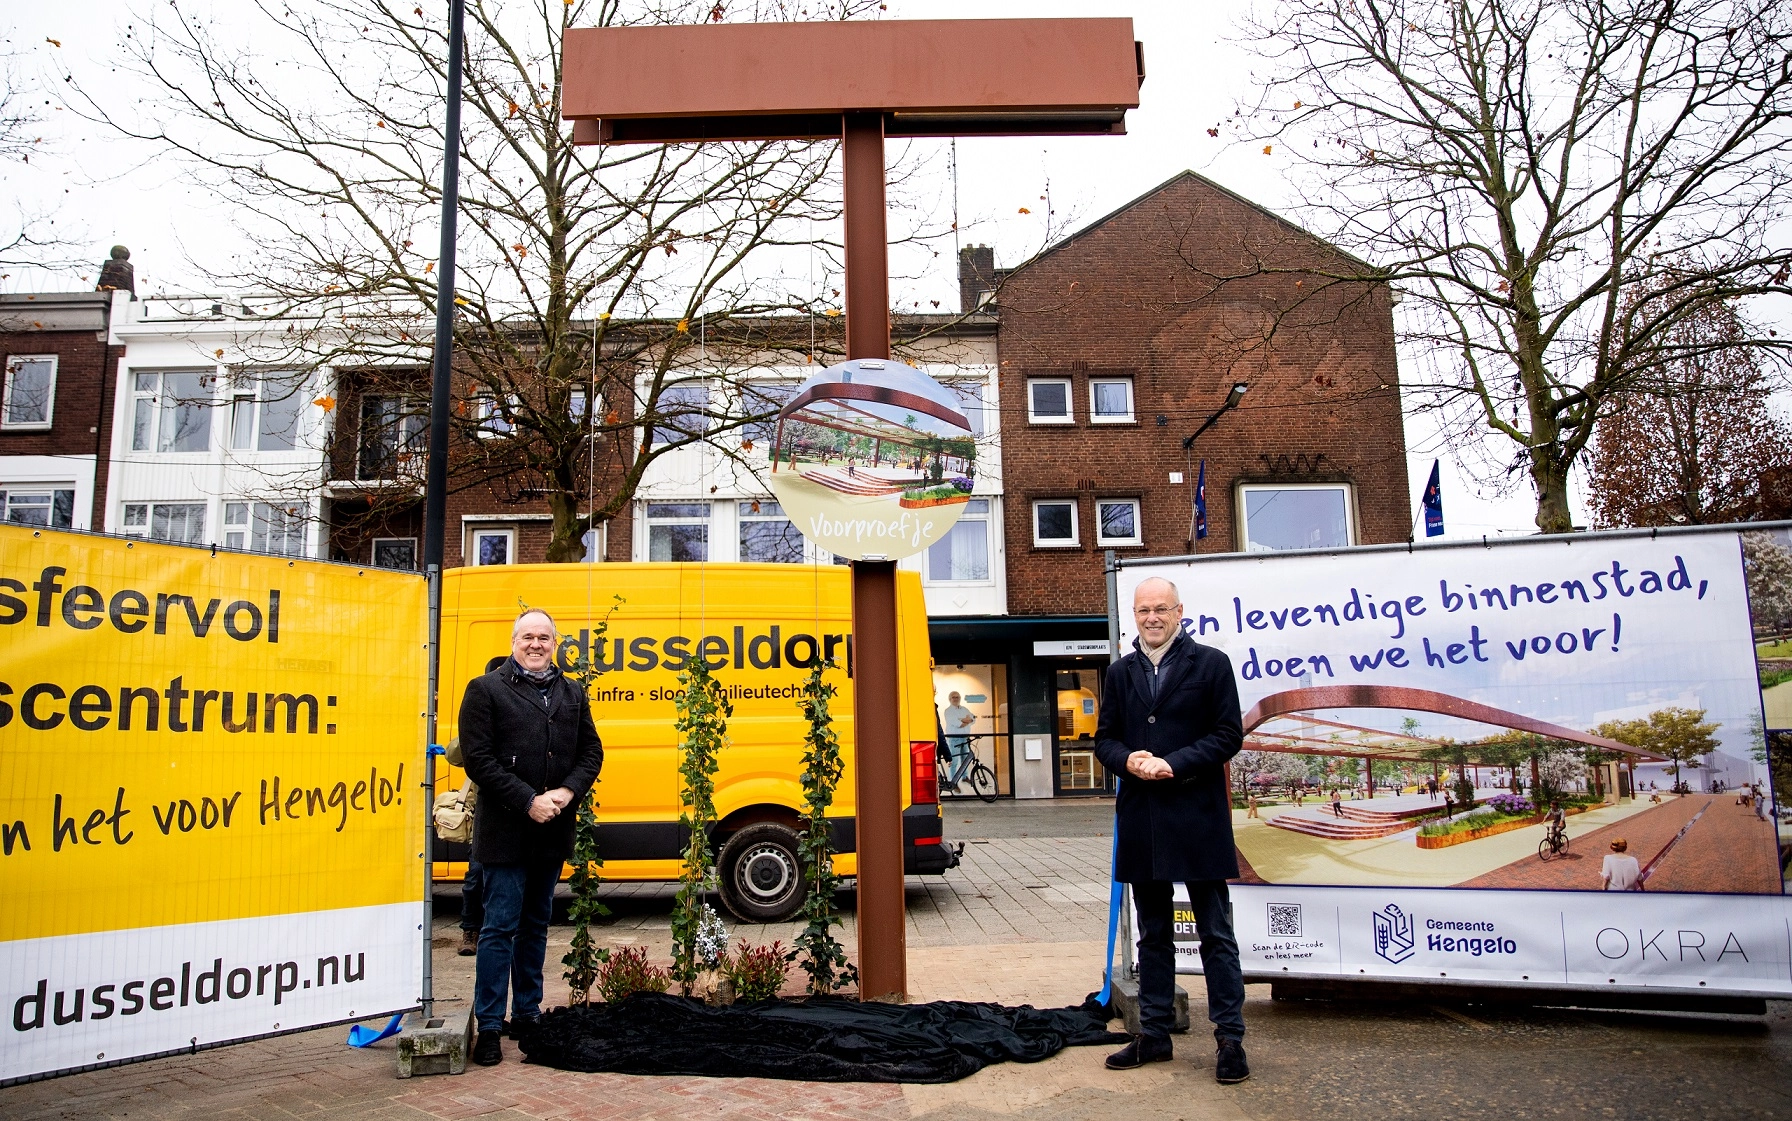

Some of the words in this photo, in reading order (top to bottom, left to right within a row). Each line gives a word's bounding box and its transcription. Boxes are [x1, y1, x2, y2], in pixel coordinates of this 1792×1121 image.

[810, 512, 934, 547] Voorproefje
[0, 565, 280, 643] sfeervol
[1180, 614, 1220, 636] en
[1233, 588, 1427, 639] levendige
[1439, 555, 1708, 613] binnenstad,
[555, 624, 853, 679] dusseldor
[1241, 647, 1335, 681] doen
[1349, 647, 1410, 673] we
[1422, 625, 1489, 669] het
[1505, 612, 1622, 661] voor!
[597, 687, 634, 701] infra
[649, 686, 686, 701] sloo
[715, 682, 838, 699] milieutechk
[53, 787, 134, 852] het
[152, 791, 242, 835] voor
[260, 763, 404, 832] Hengelo!
[1174, 922, 1197, 934] OET
[1426, 919, 1495, 932] Gemeente
[1252, 943, 1271, 952] Scan
[1274, 941, 1283, 950] de
[1275, 951, 1291, 960] lees
[1427, 933, 1517, 956] Hengelo
[1595, 926, 1750, 963] OKRA
[13, 951, 366, 1031] dusseldorp.nu
